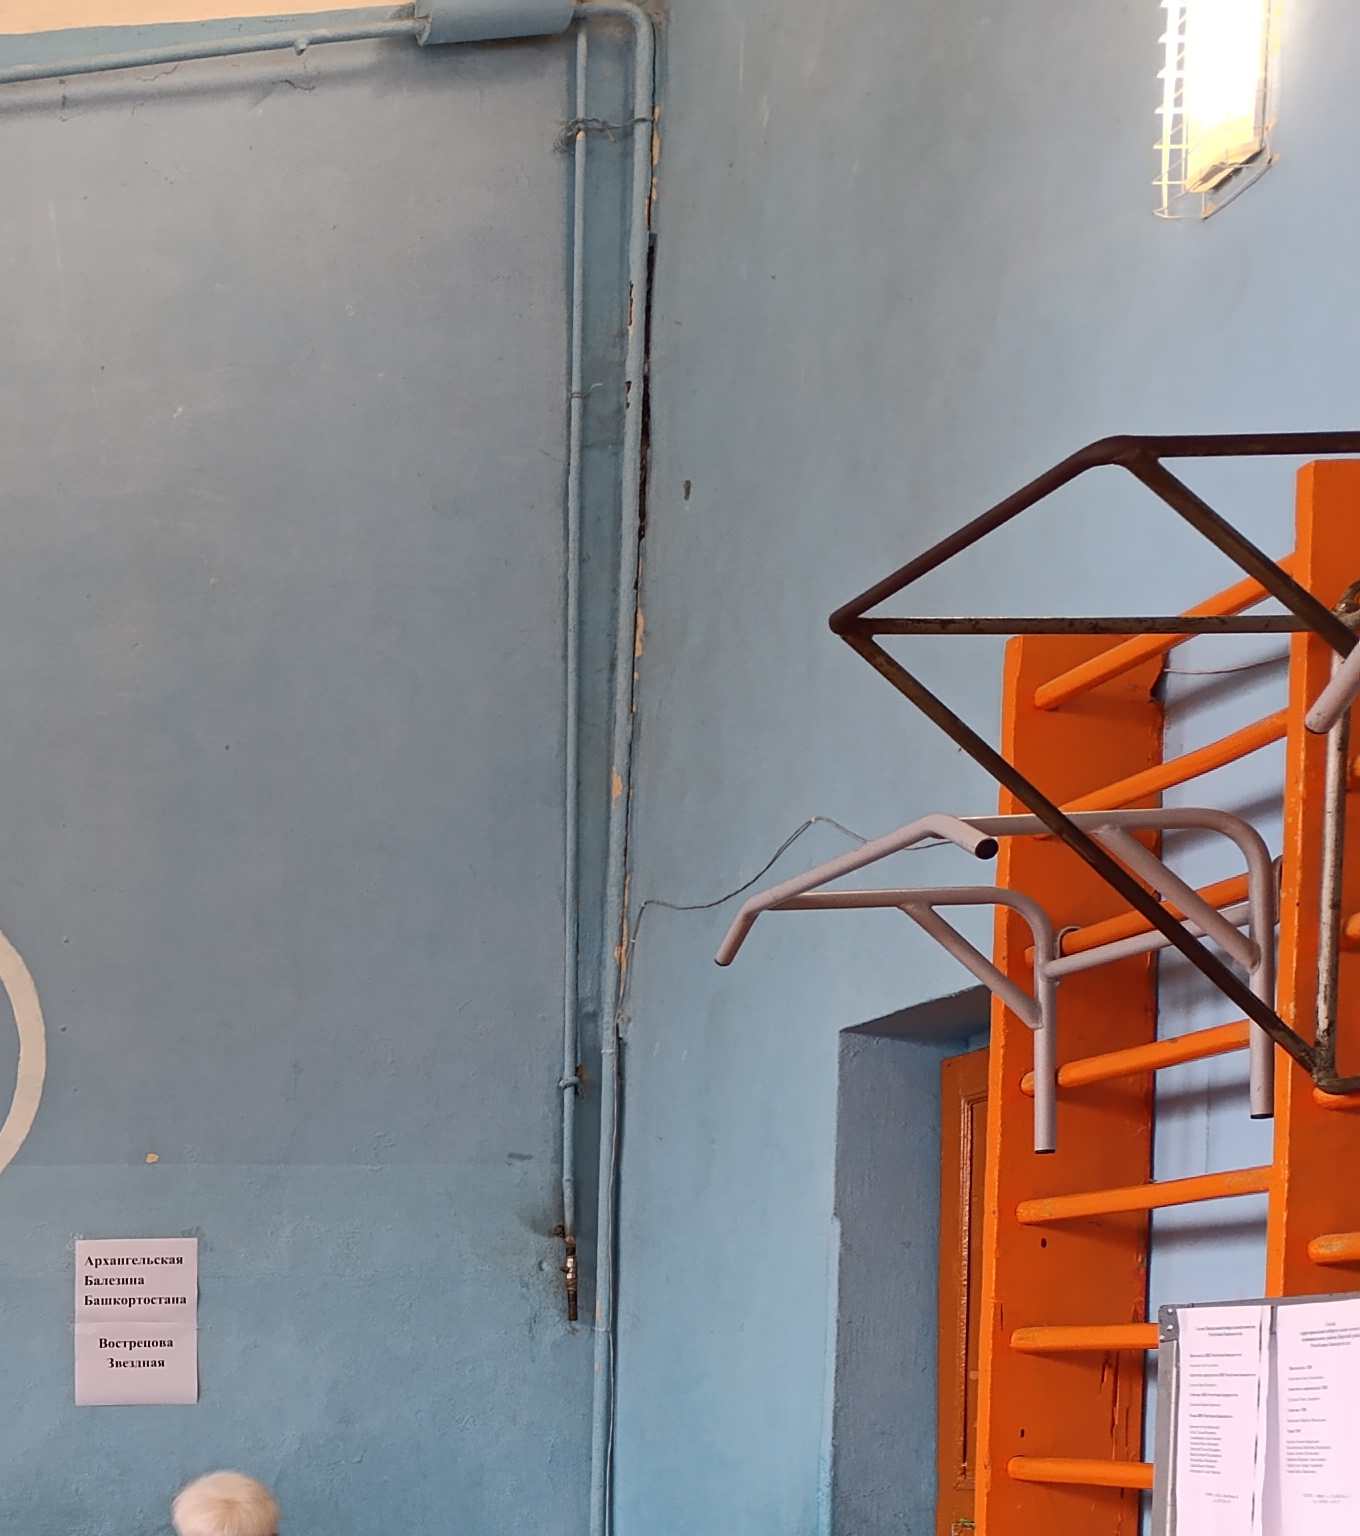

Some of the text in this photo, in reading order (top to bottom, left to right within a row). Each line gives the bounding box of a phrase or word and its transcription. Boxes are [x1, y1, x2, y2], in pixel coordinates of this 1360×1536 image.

[84, 1256, 184, 1268] Архангельская
[84, 1275, 145, 1286] Балезина
[84, 1295, 187, 1307] Башкортостана
[99, 1338, 174, 1350] Вострецова
[107, 1358, 166, 1369] Звездная
